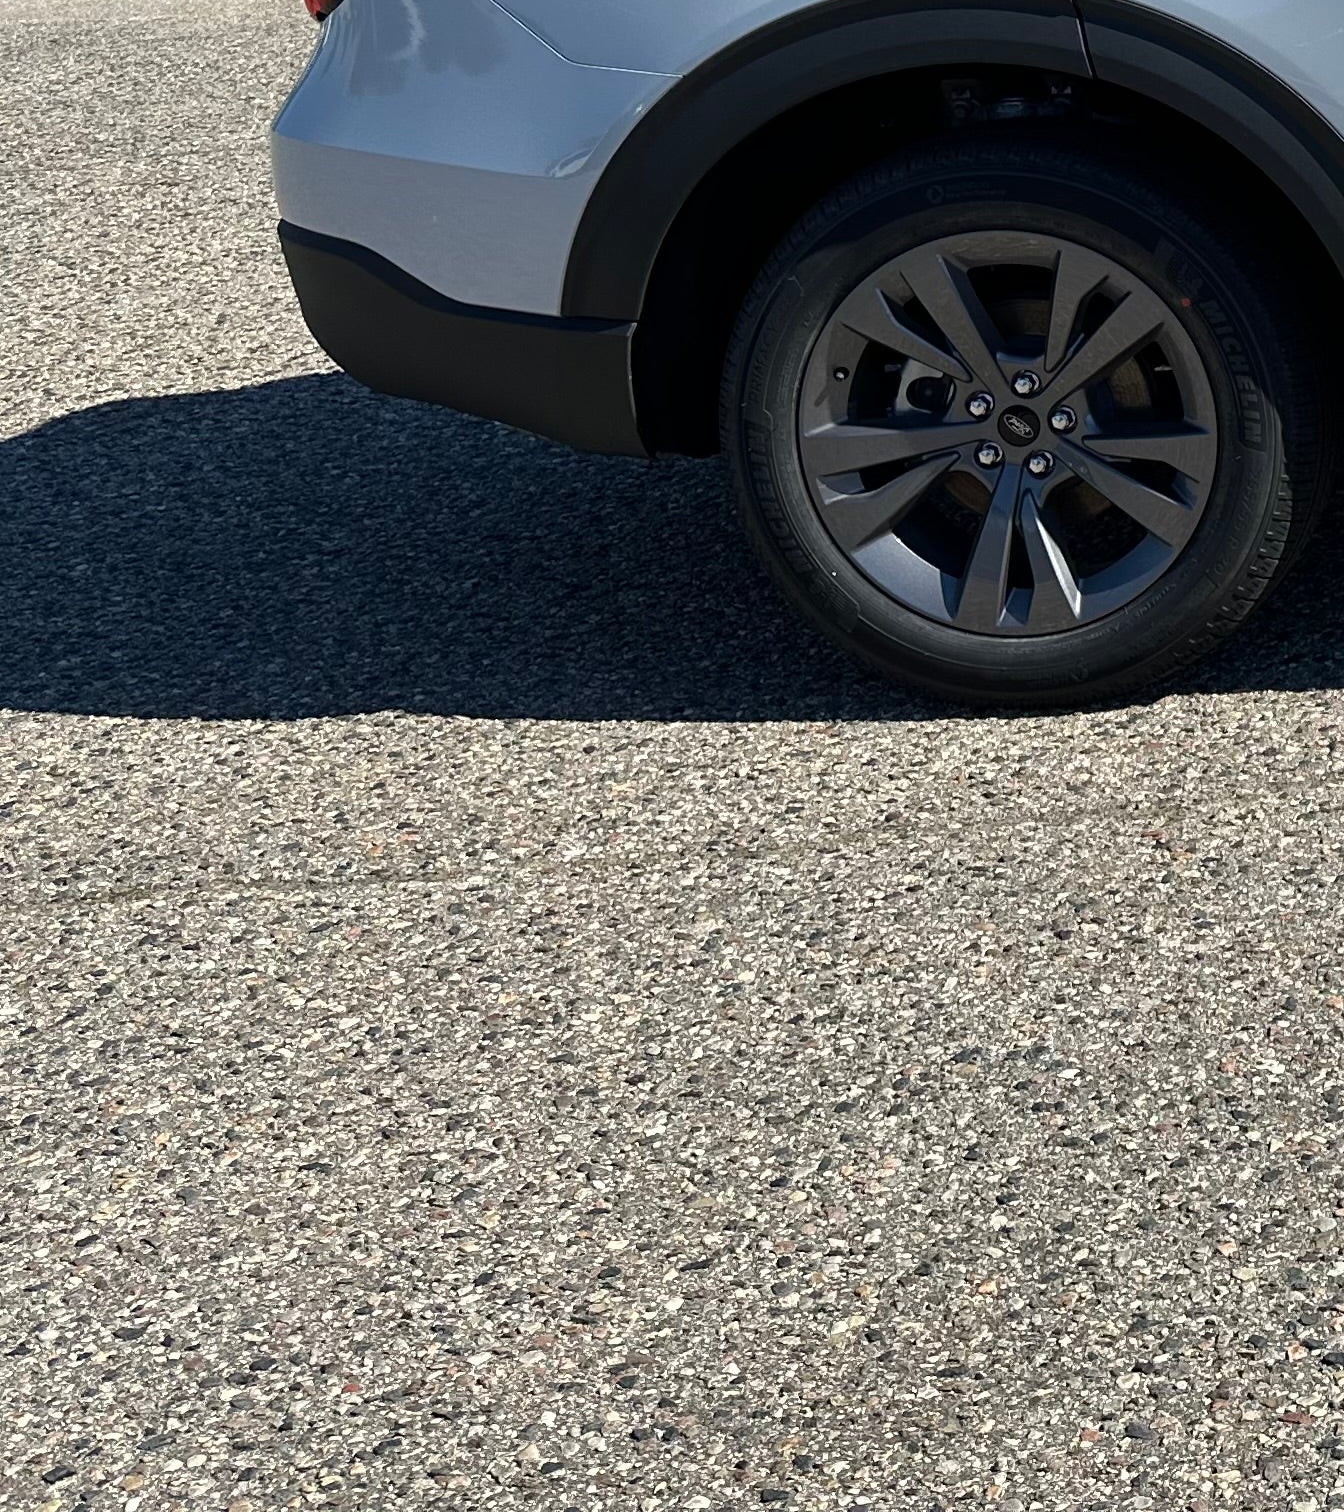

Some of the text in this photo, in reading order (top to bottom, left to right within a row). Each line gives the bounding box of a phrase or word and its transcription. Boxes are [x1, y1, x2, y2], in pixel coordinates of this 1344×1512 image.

[1006, 417, 1031, 436] Ford
[1201, 299, 1263, 444] MICHELIN
[750, 431, 814, 573] MICHELIN
